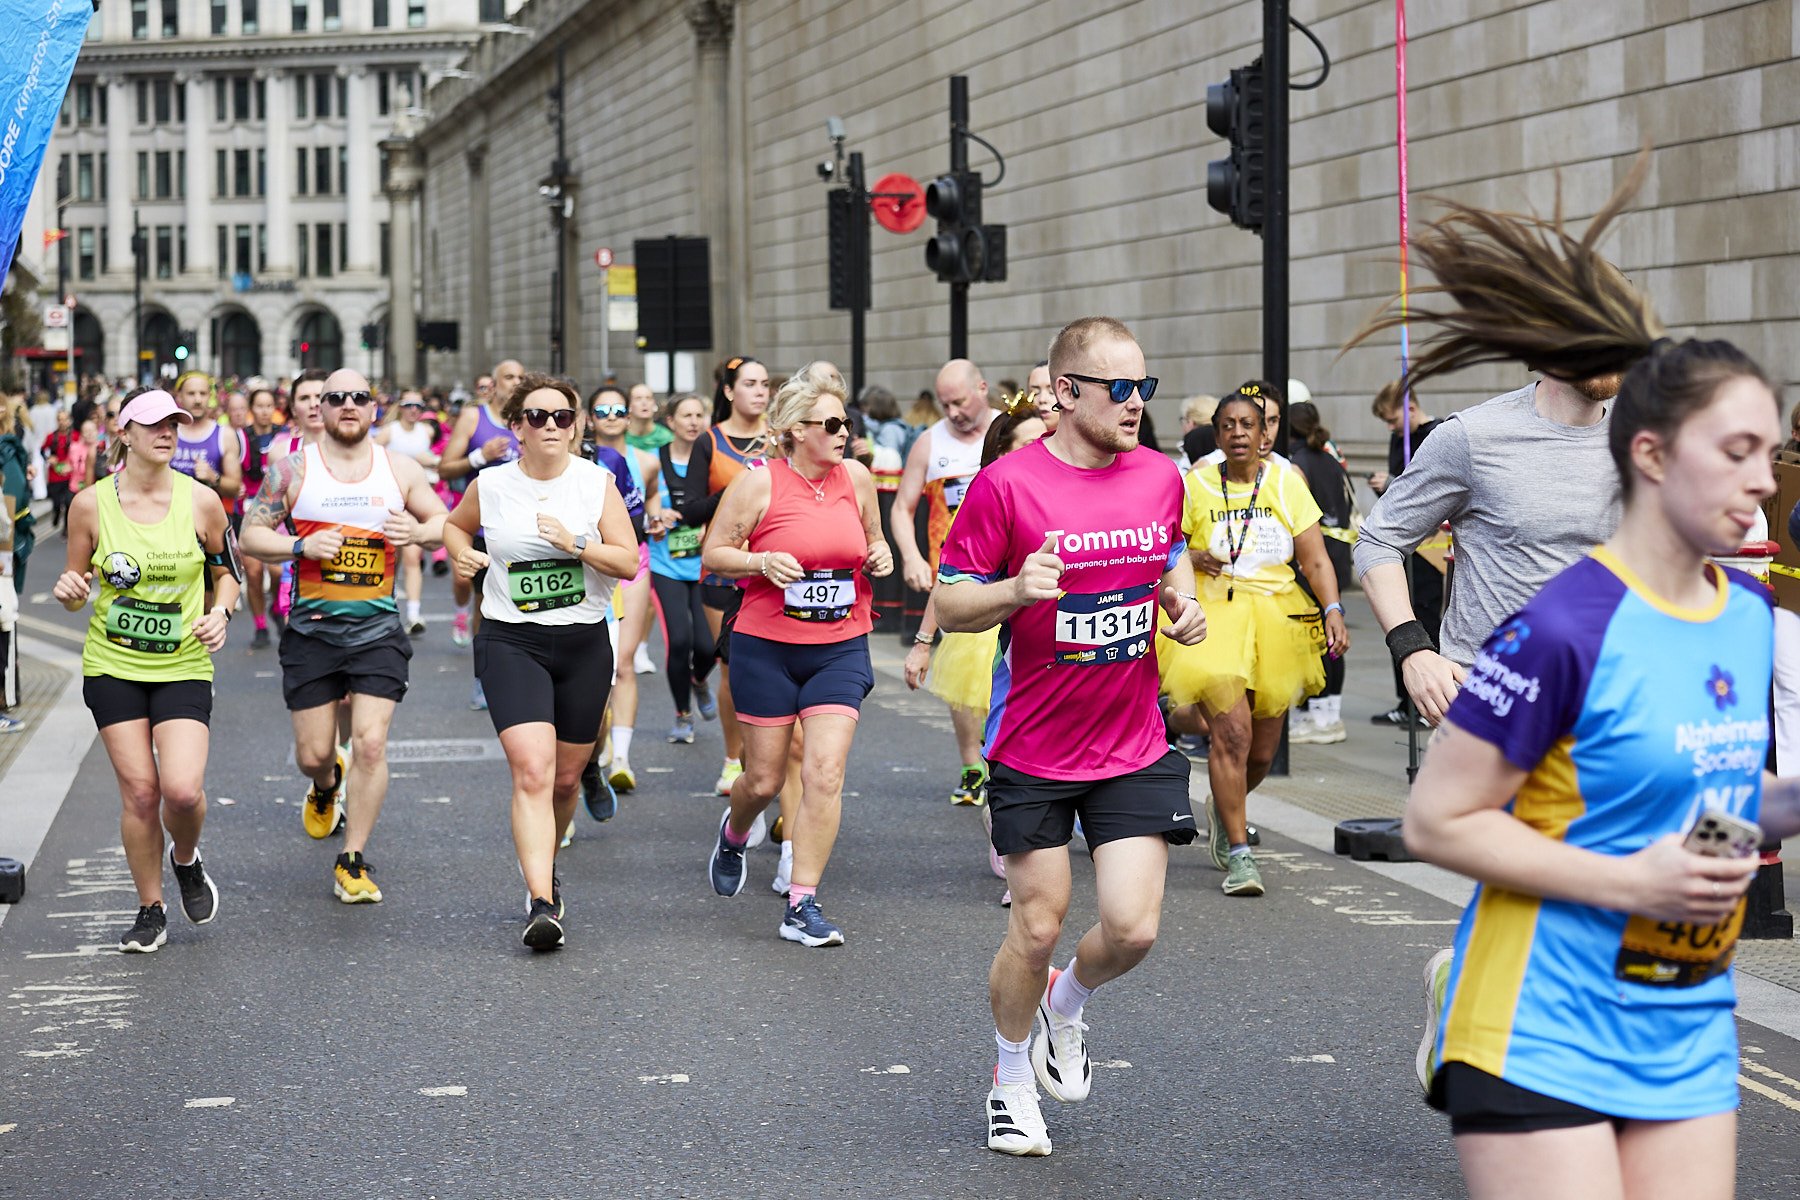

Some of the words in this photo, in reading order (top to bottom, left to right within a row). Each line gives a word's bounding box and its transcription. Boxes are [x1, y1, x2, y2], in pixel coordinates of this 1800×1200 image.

[14, 30, 50, 119] Kingston
[1210, 506, 1272, 523] Lorrane
[1044, 521, 1168, 554] Tommy's
[146, 551, 193, 560] Cheltenham
[1065, 559, 1107, 570] pregnancy
[1109, 556, 1125, 565] and
[1127, 554, 1147, 563] baby
[146, 563, 177, 572] Animal
[532, 561, 557, 569] ALISON
[146, 574, 177, 582] Shelter
[520, 571, 574, 595] 6162
[803, 585, 840, 603] 497
[1097, 593, 1124, 605] JAMIE
[134, 602, 159, 611] LOUISE
[117, 612, 172, 636] 6709
[1065, 605, 1149, 640] 11314
[1691, 742, 1760, 777] Society
[1657, 911, 1735, 949] 40
